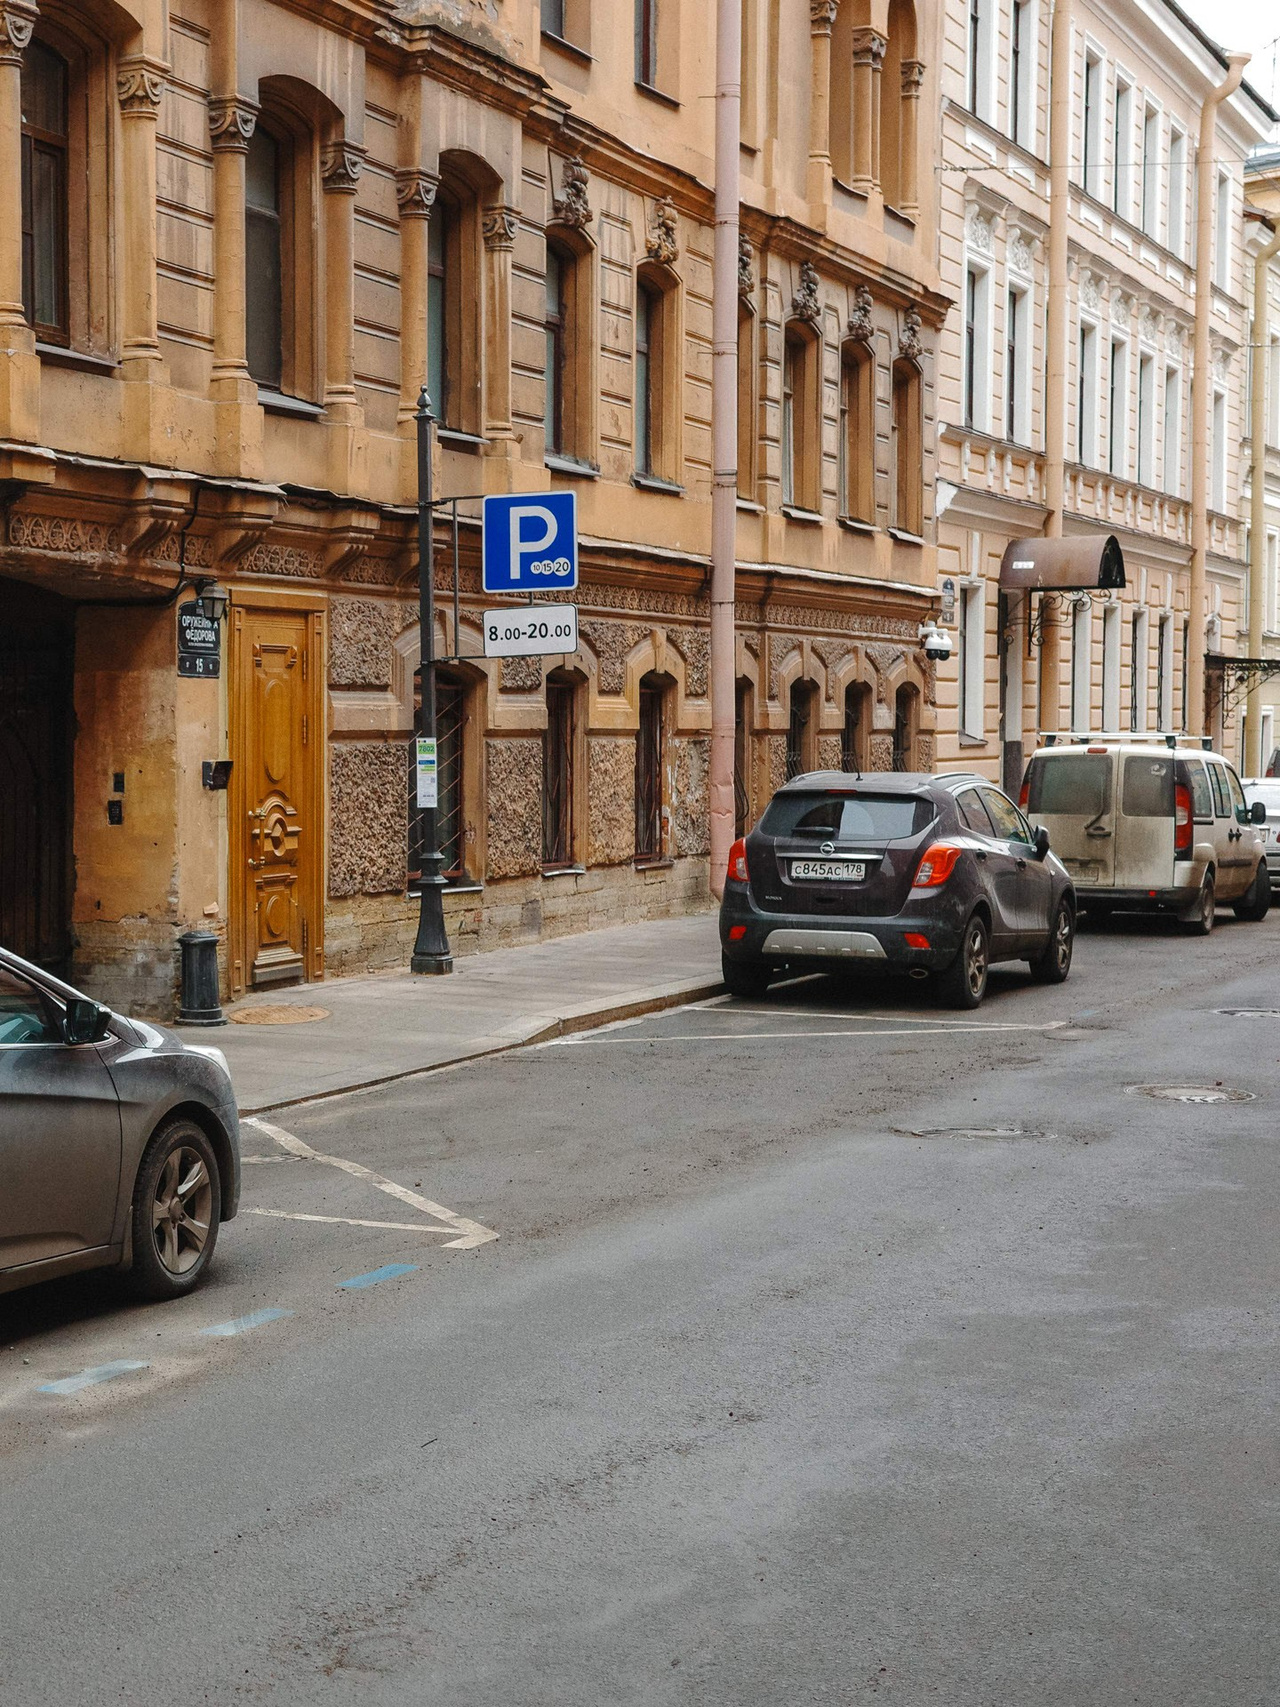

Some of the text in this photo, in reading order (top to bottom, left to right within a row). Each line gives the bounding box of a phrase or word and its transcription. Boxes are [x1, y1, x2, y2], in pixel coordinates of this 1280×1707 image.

[509, 505, 558, 580] P
[532, 561, 569, 573] 10 15 20
[488, 622, 571, 642] 8.00-20.00
[196, 658, 203, 672] 15
[794, 863, 862, 876] С845АС 178
